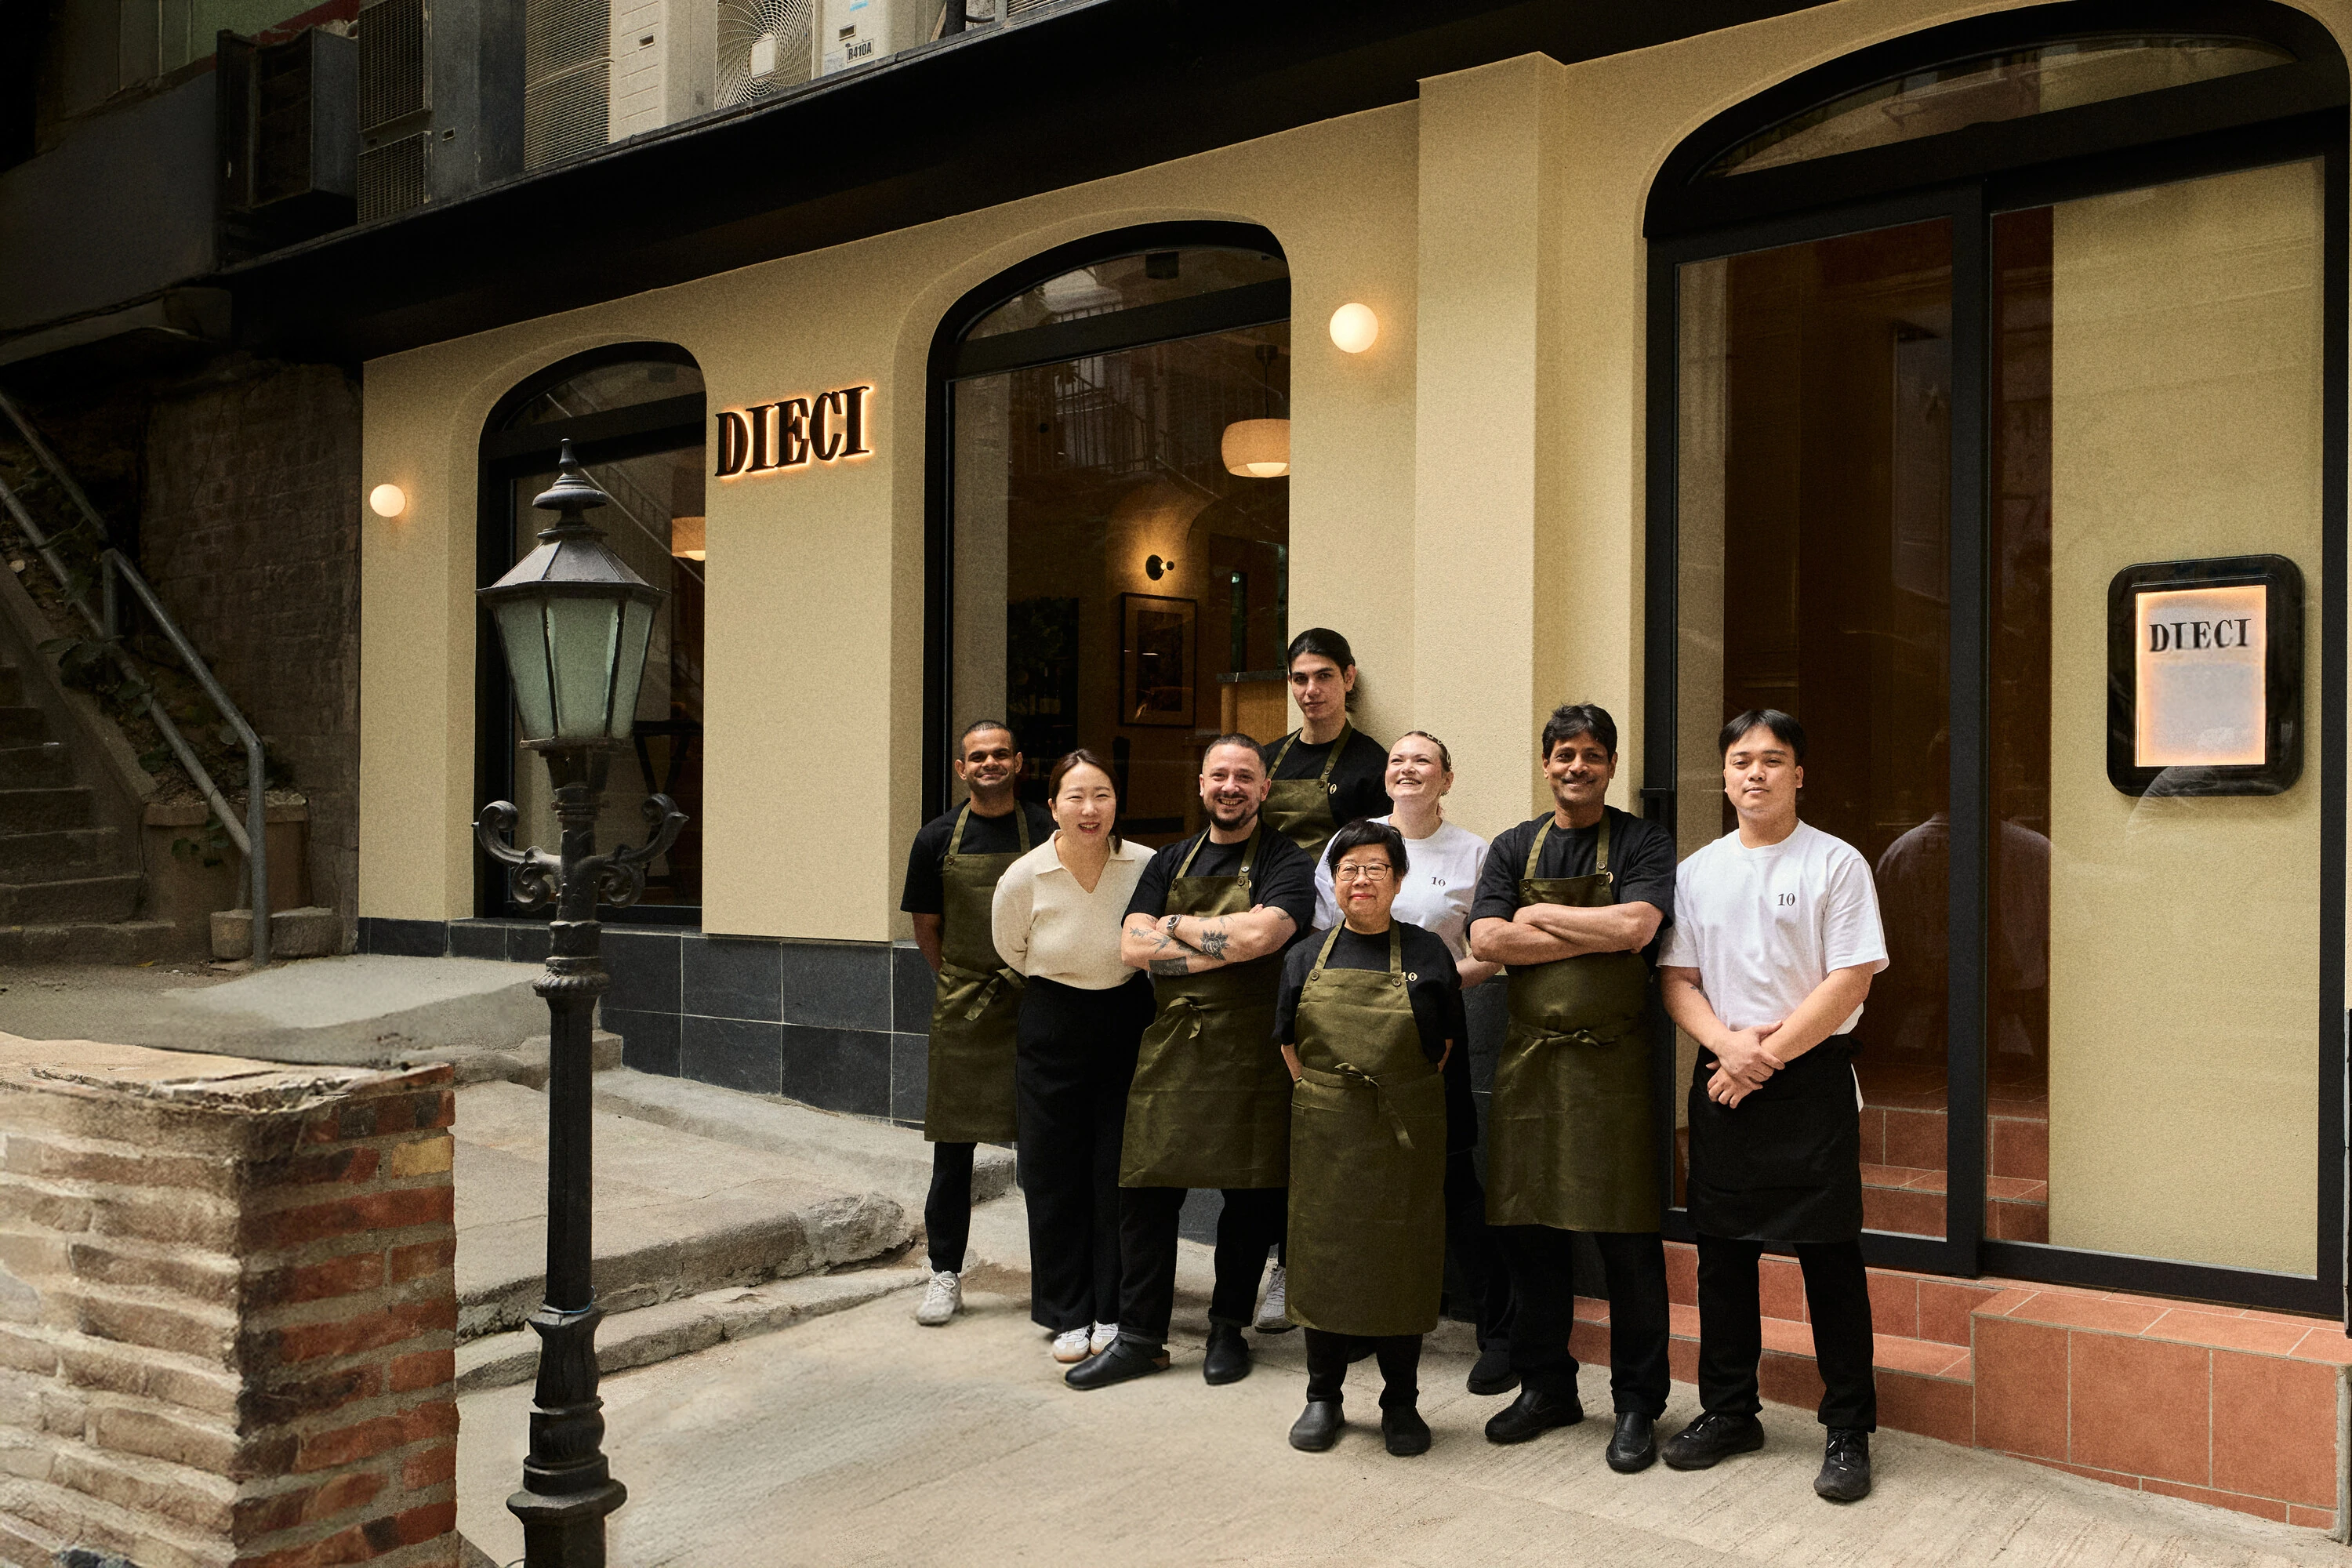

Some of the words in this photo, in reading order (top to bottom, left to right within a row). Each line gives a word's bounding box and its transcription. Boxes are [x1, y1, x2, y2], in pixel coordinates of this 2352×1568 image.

[848, 42, 872, 60] R410A
[715, 386, 869, 477] DIECI
[2149, 618, 2252, 652] DIECI
[1431, 877, 1446, 887] 10
[1777, 892, 1795, 906] 10
